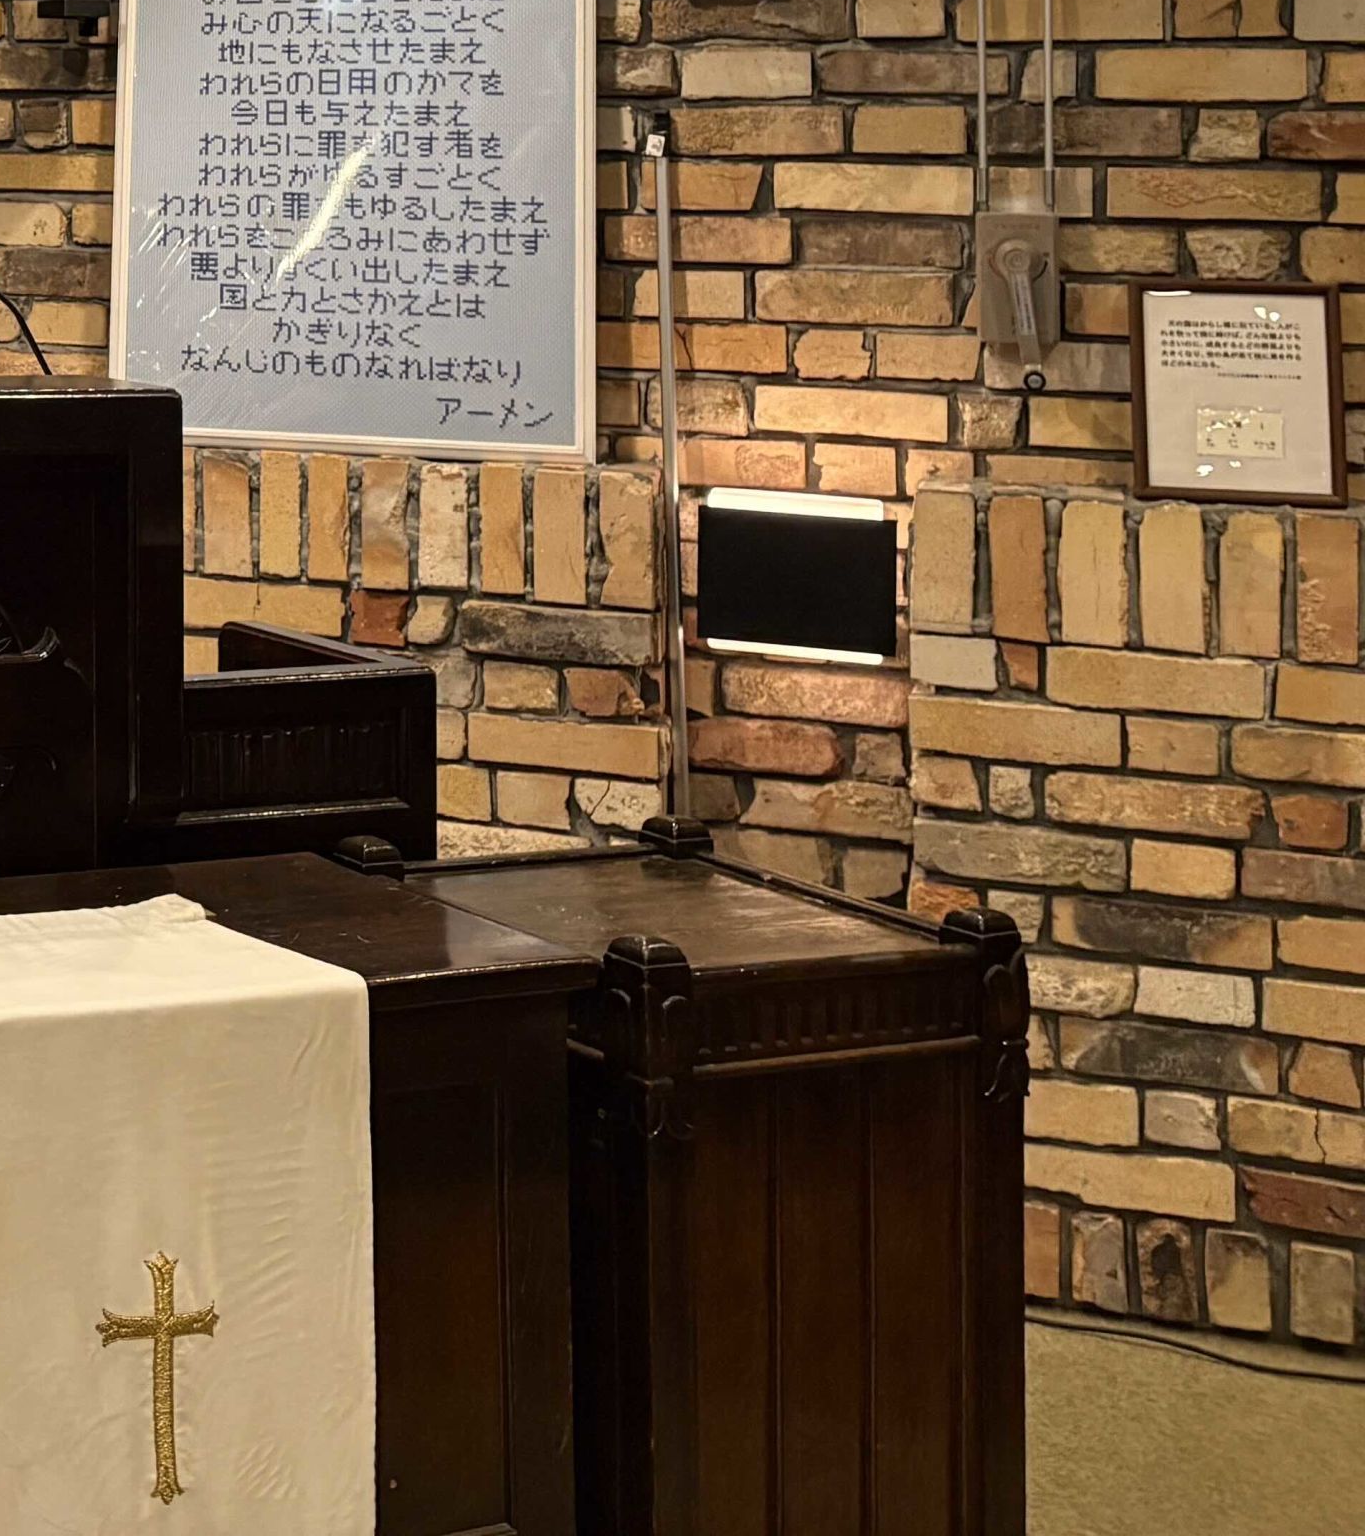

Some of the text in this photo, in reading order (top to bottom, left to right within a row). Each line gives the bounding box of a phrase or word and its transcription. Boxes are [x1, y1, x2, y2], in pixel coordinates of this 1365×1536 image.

[201, 6, 505, 35] み心の天になるごとく
[218, 38, 486, 65] 地にもなさせたまえ
[199, 68, 505, 96] われらの日用のかてを
[231, 99, 469, 126] 今日も与えたまえ
[198, 129, 504, 159] われらに罪を犯す者を
[158, 191, 549, 224] われらの罪もゆるしたまえ
[158, 223, 550, 255] われらをころみにあわせず
[219, 284, 486, 318] 国と力とさかえとは
[273, 317, 422, 346] かぎりなく
[181, 345, 522, 387] なんじのものなればなり
[436, 397, 553, 428] アーメン
